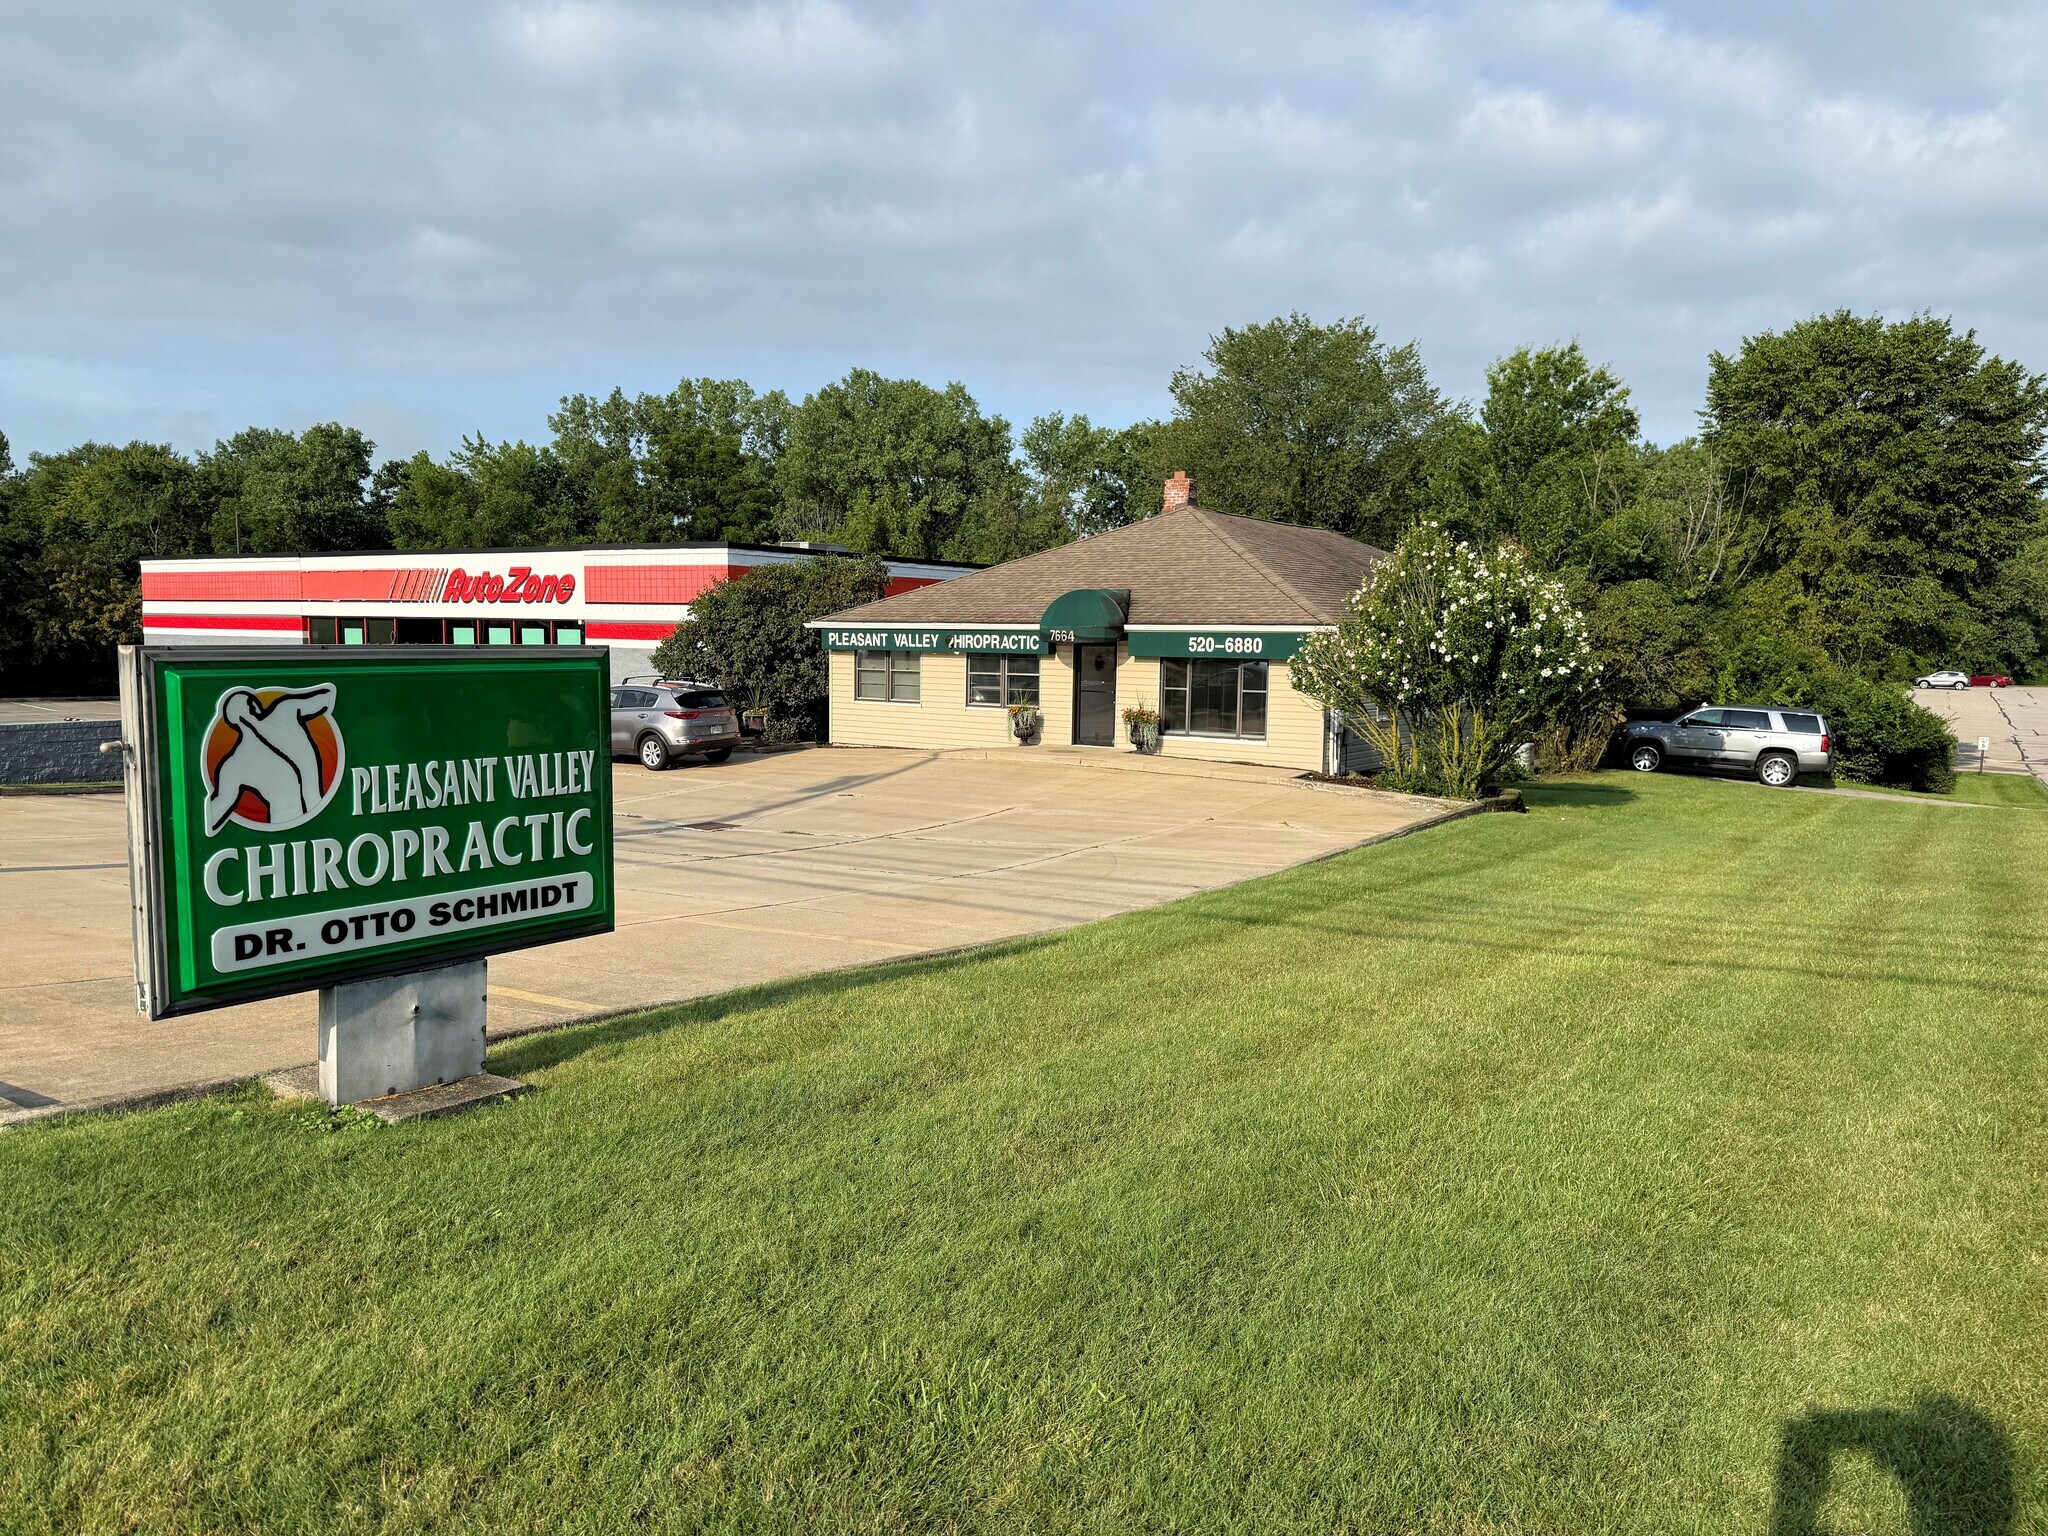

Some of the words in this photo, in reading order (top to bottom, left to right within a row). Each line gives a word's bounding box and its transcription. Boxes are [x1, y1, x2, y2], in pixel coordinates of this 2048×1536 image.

[442, 566, 576, 604] AutoZone
[828, 632, 888, 647] PLEASANT
[893, 633, 939, 648] VALLEY
[1049, 629, 1075, 642] 7664
[1188, 636, 1263, 653] 520-6880
[351, 756, 498, 816] PLEASANT
[505, 750, 596, 800] VALLEY
[203, 808, 594, 907] CHIROPRACTIC
[234, 928, 307, 962] DR.
[326, 907, 416, 946] OTTO
[428, 881, 579, 926] SCHMIDT
